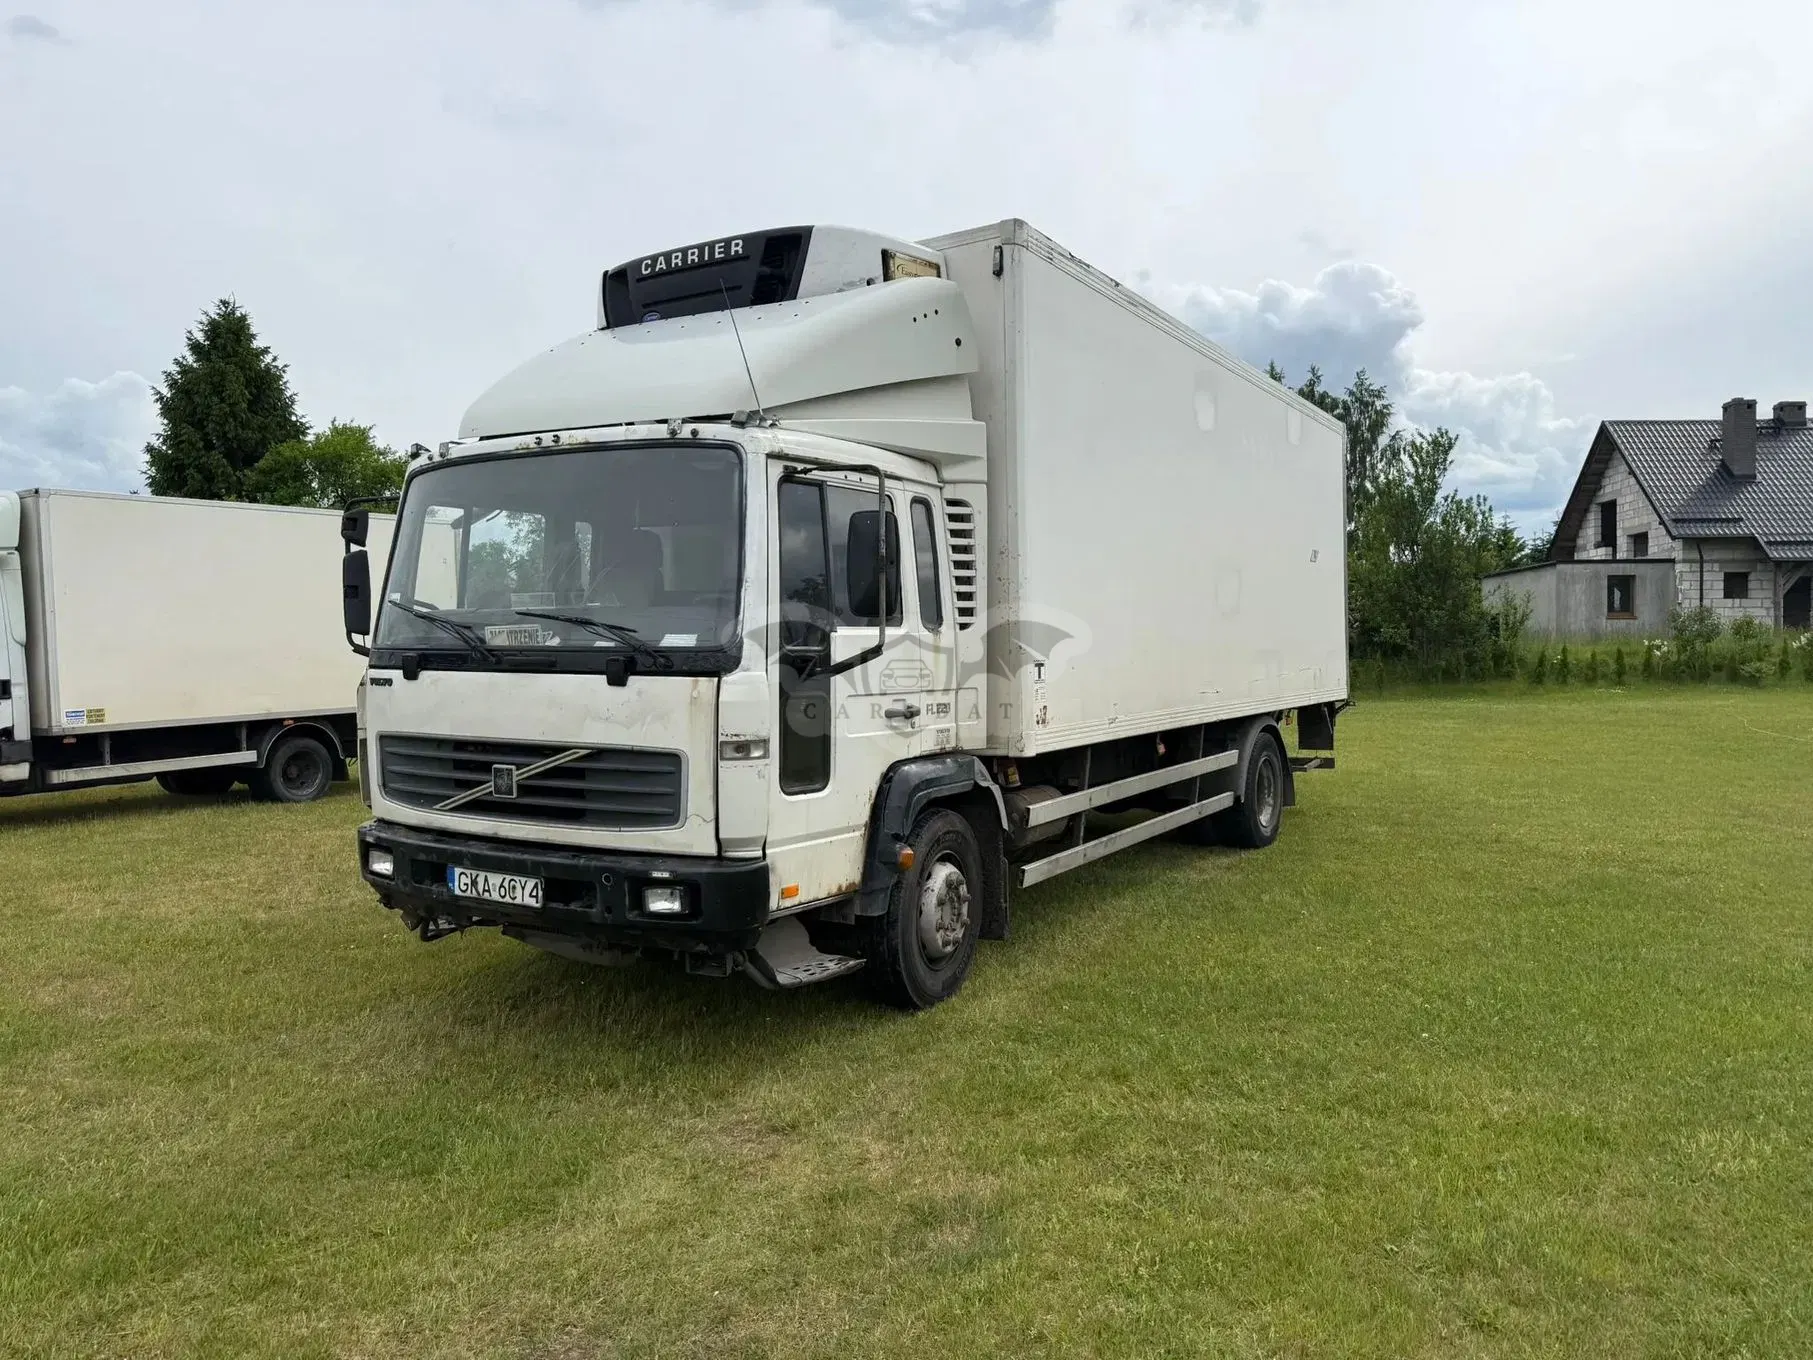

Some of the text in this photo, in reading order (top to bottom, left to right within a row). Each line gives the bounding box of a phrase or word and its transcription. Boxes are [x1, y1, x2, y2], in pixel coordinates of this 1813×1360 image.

[641, 240, 743, 274] CARRIER
[458, 871, 540, 904] GKA 6CY4
